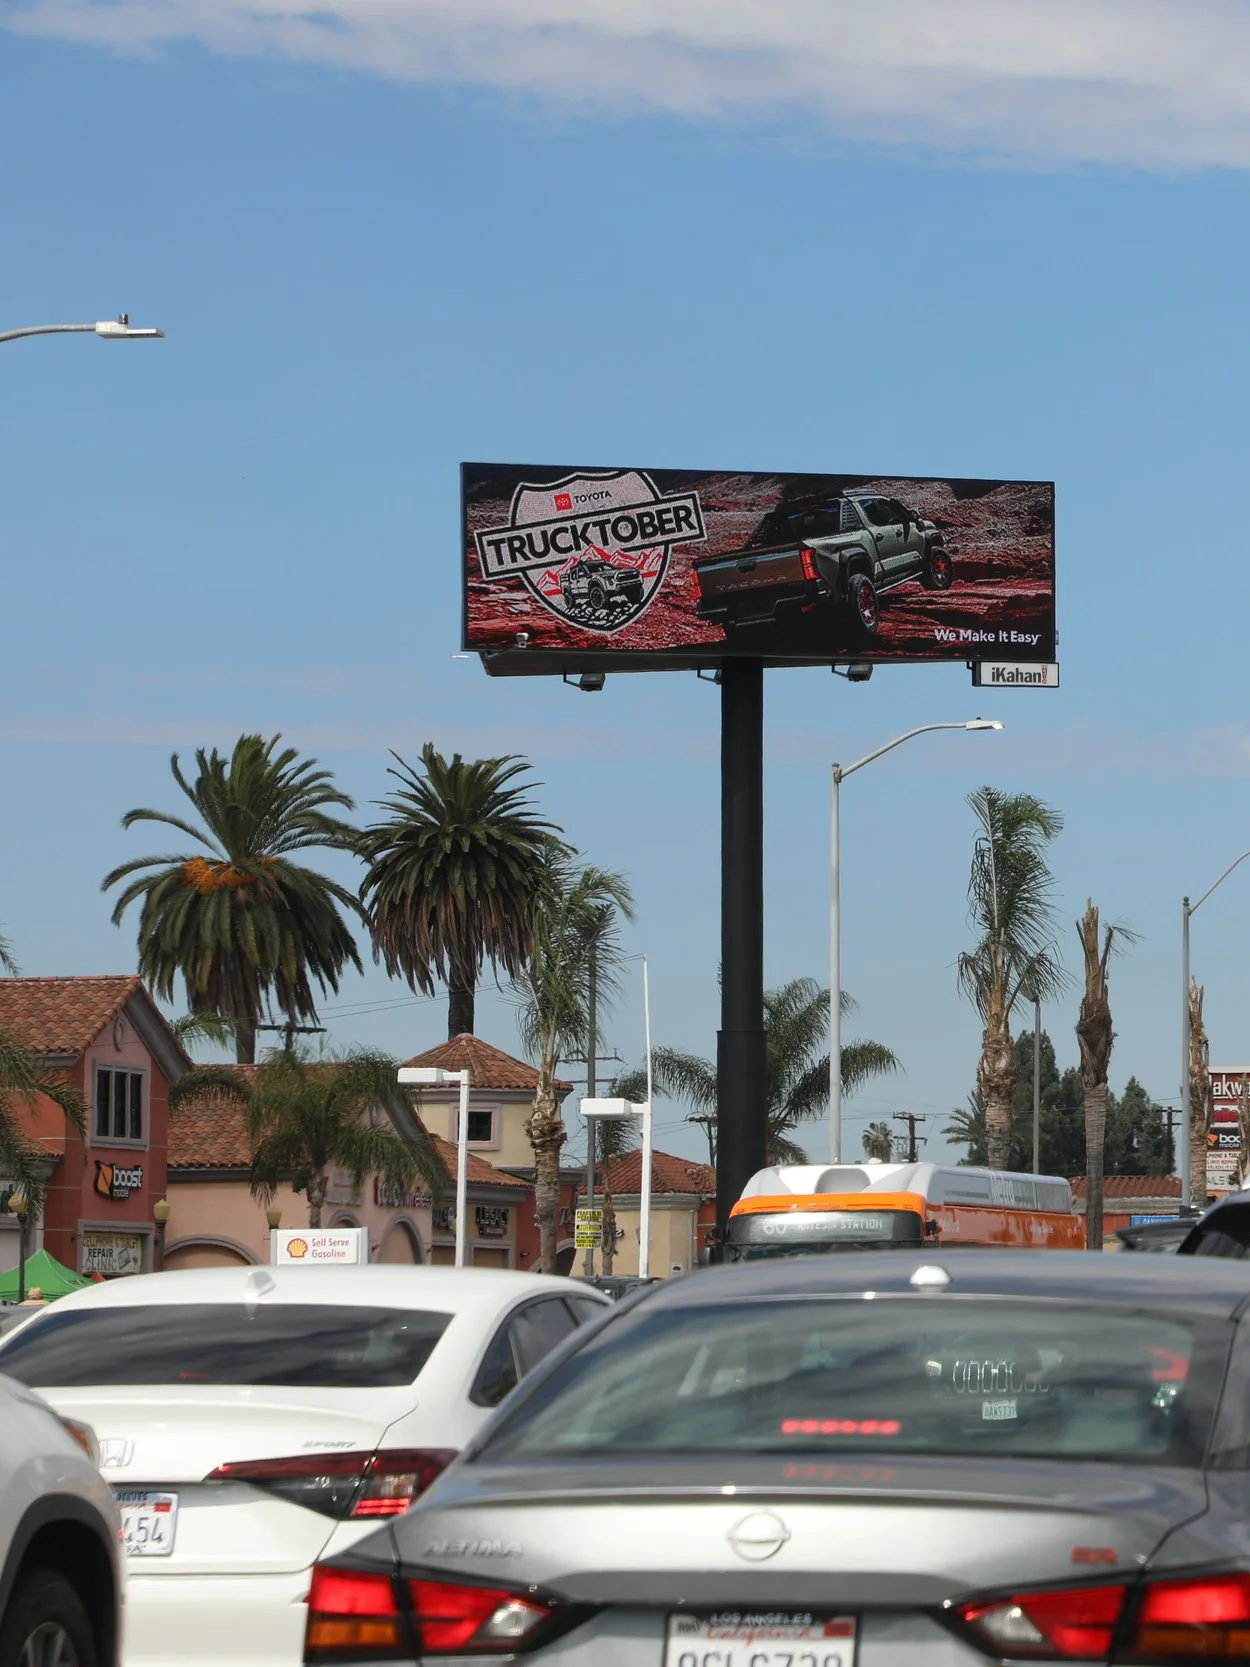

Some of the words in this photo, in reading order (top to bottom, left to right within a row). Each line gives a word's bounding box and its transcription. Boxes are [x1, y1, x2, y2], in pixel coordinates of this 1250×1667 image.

[574, 490, 612, 503] TOYOTA
[487, 504, 697, 566] TRUCKTOBER
[934, 629, 956, 641] We
[960, 630, 995, 642] Make
[999, 630, 1008, 642] It
[1011, 631, 1039, 645] Easy
[113, 1165, 143, 1188] boost
[112, 1188, 129, 1198] mobile
[762, 1219, 787, 1235] 60
[840, 1219, 882, 1230] STATION
[312, 1238, 327, 1247] Self
[329, 1238, 349, 1247] Serve
[88, 1248, 113, 1258] REPAIR
[312, 1249, 346, 1258] Gasoline
[86, 1257, 117, 1271] CLINIC
[423, 1539, 524, 1558] ALTIMA
[710, 1613, 741, 1626] LOS
[742, 1612, 812, 1626] ANGELES
